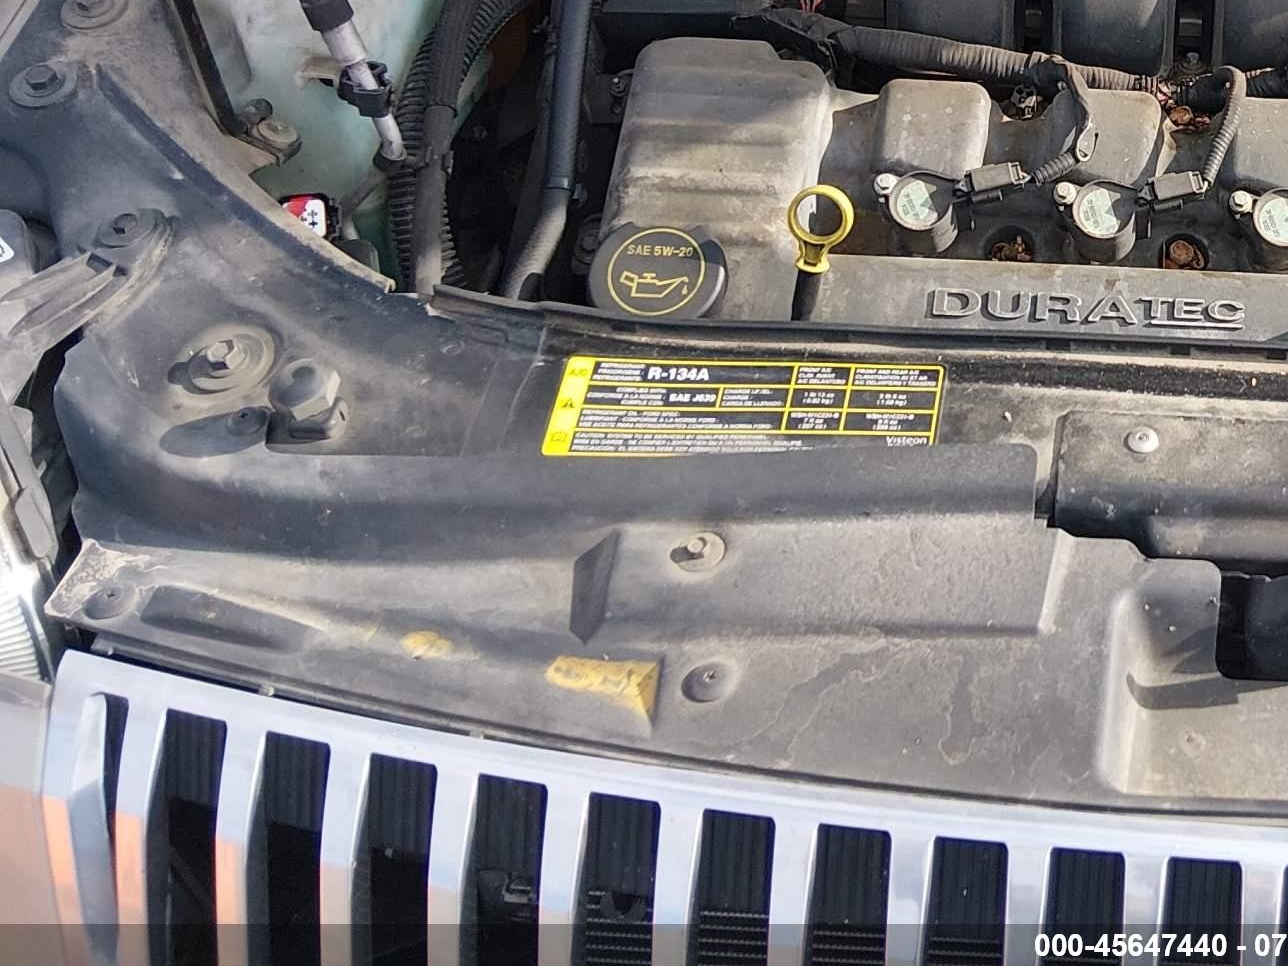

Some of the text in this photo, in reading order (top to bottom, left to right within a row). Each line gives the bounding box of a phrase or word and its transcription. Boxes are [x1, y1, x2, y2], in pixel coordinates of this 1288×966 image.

[626, 244, 694, 257] SAE 5W-20
[928, 286, 1246, 327] DURATEC
[646, 366, 711, 382] R-134A
[668, 393, 691, 402] SAE
[886, 436, 928, 447] Visteon
